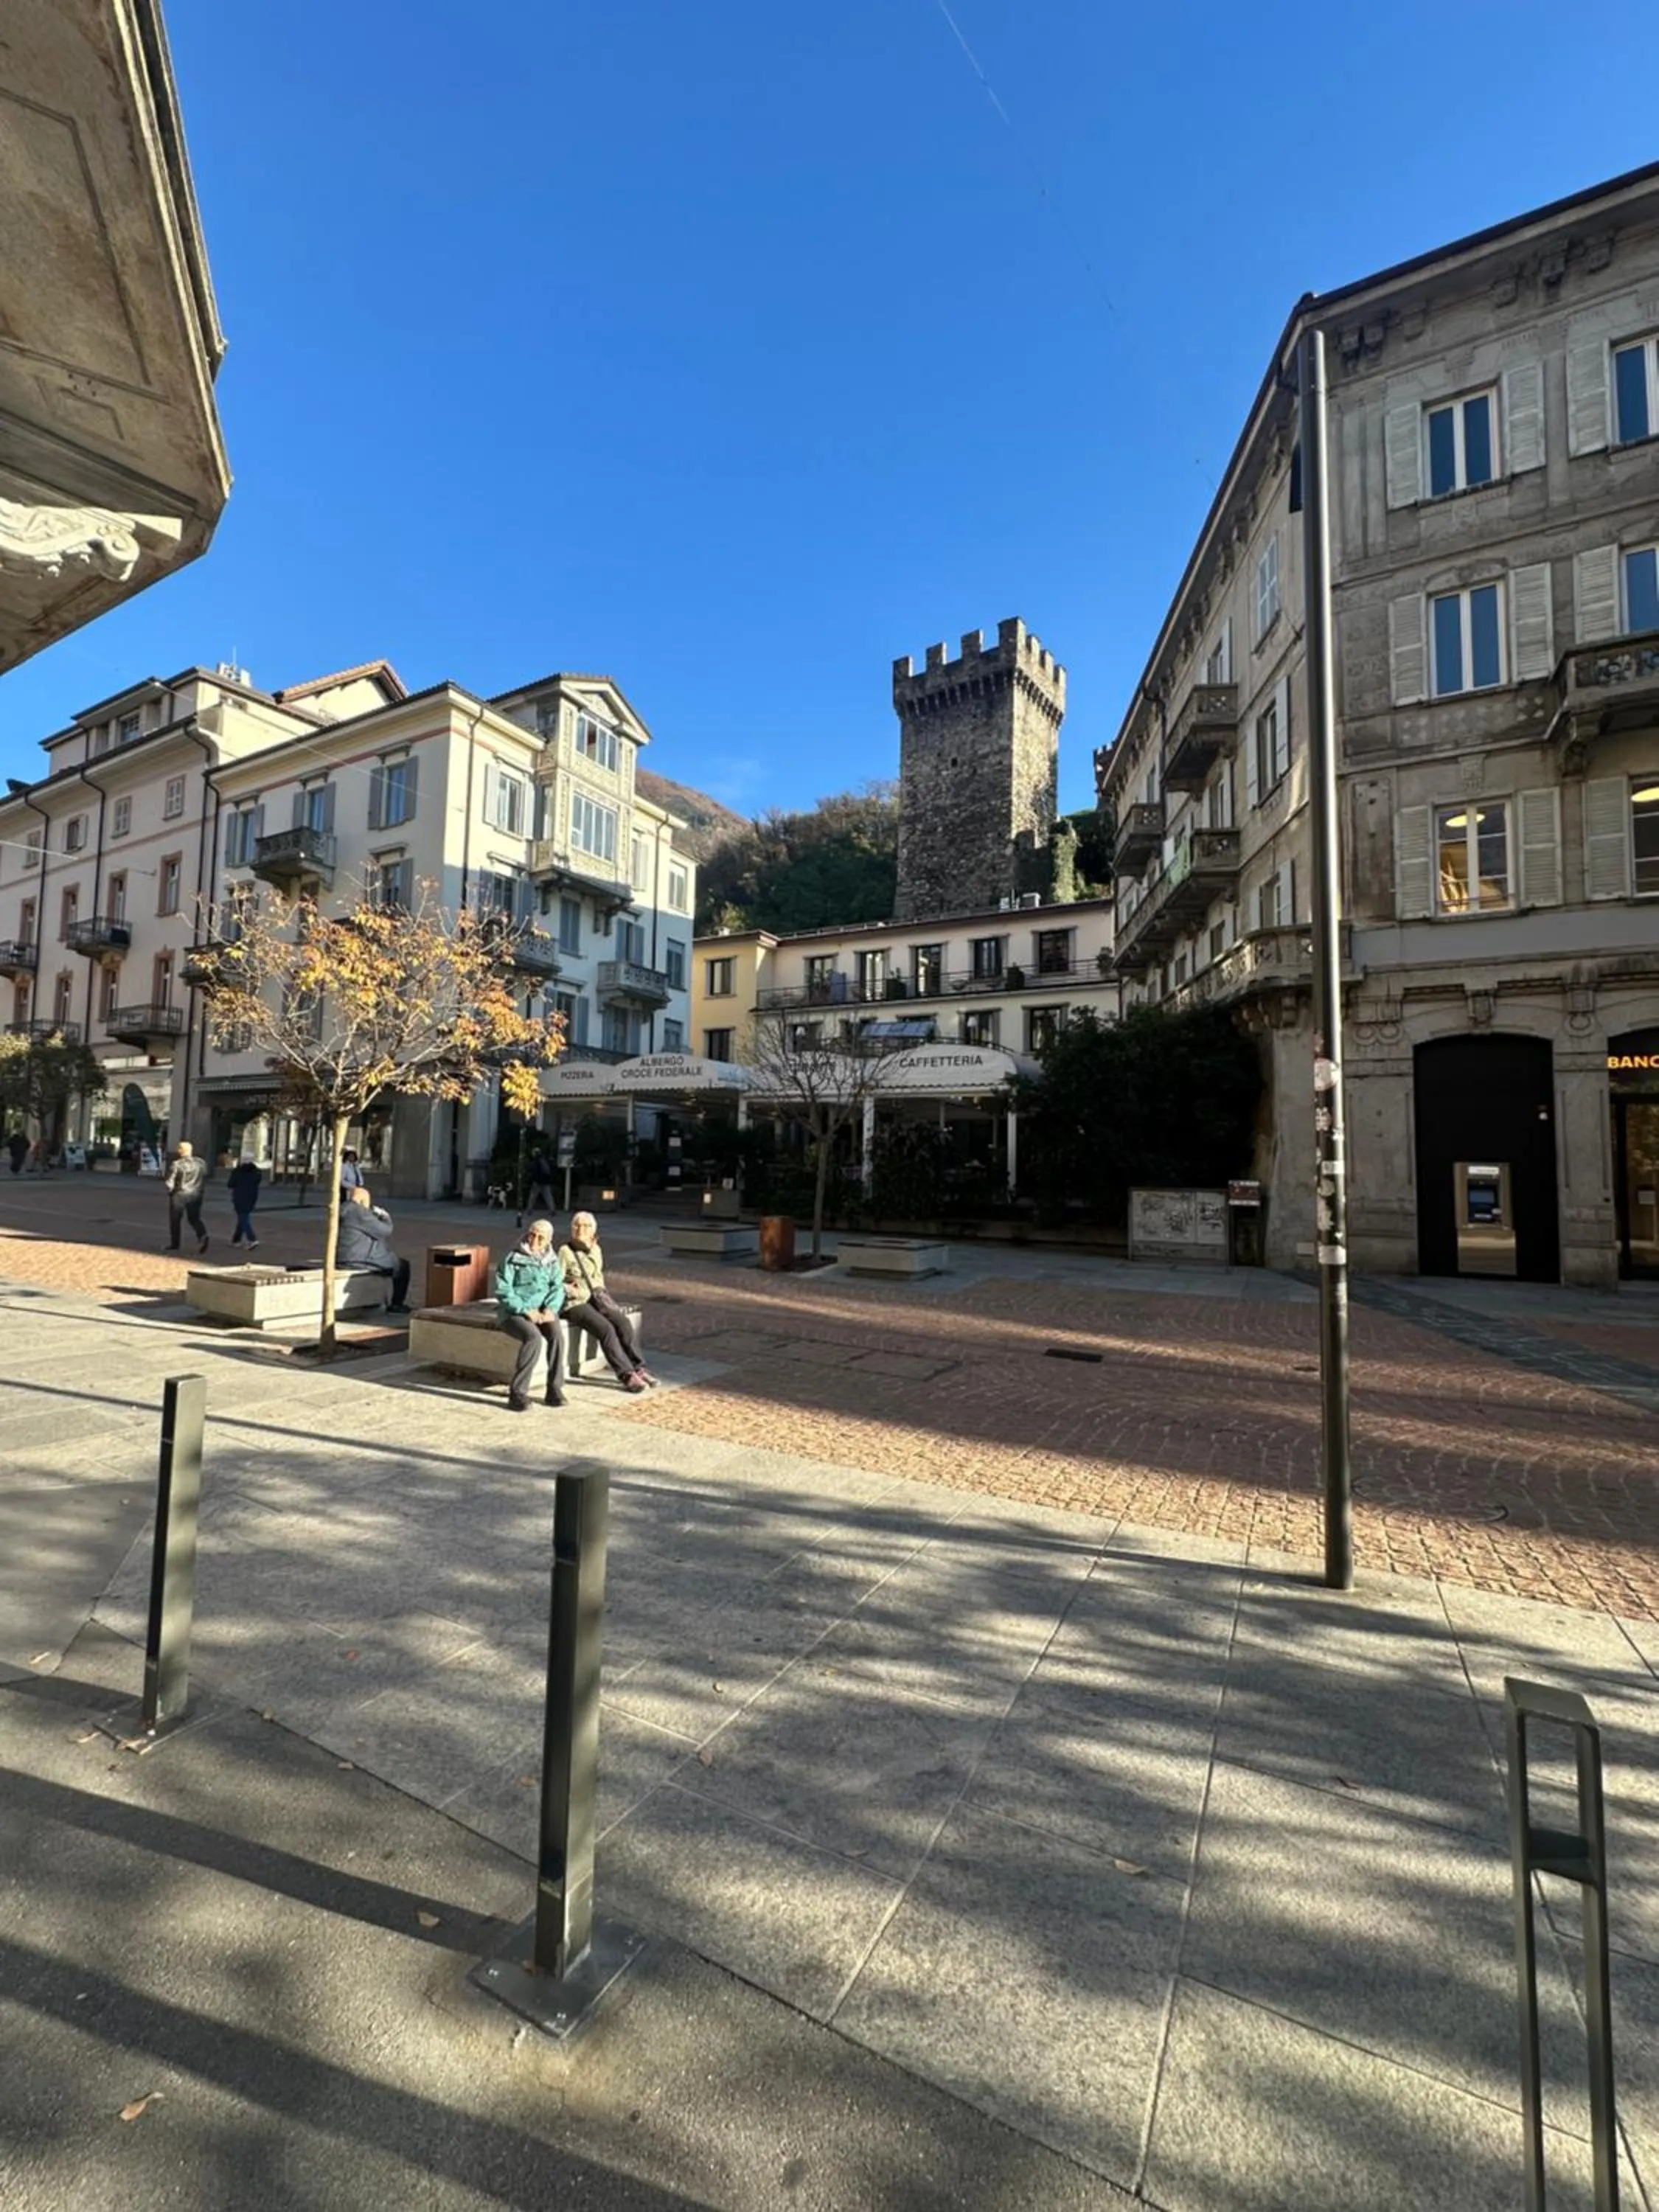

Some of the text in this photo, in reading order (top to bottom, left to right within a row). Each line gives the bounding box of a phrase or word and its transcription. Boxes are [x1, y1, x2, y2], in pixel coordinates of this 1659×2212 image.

[640, 1055, 684, 1067] ALBERGO
[900, 1054, 983, 1068] CAFFETTERIA
[621, 1065, 704, 1079] CROCE FEDERALE
